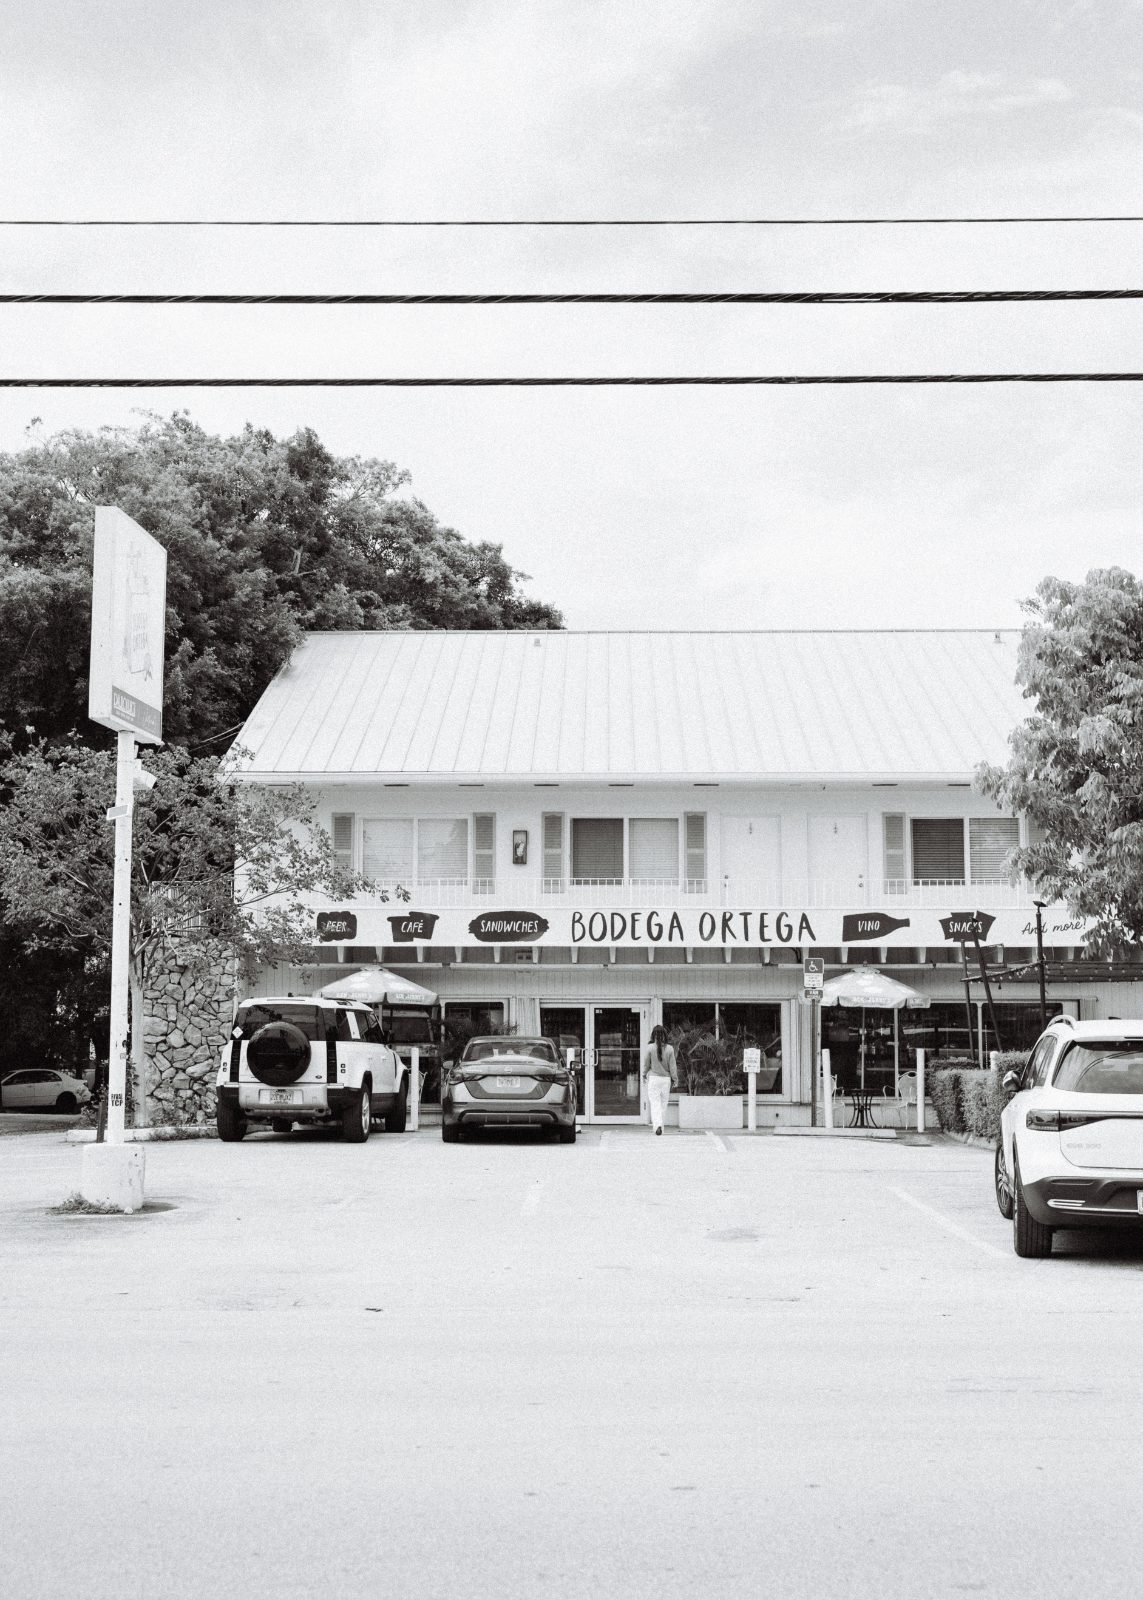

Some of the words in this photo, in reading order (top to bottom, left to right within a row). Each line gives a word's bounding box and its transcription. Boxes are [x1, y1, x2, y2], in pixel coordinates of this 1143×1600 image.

[480, 919, 539, 933] SANDWICHES
[572, 911, 684, 942] BODEGA
[699, 911, 816, 943] ORTEGA
[858, 920, 880, 931] VINO
[1053, 918, 1087, 932] more!
